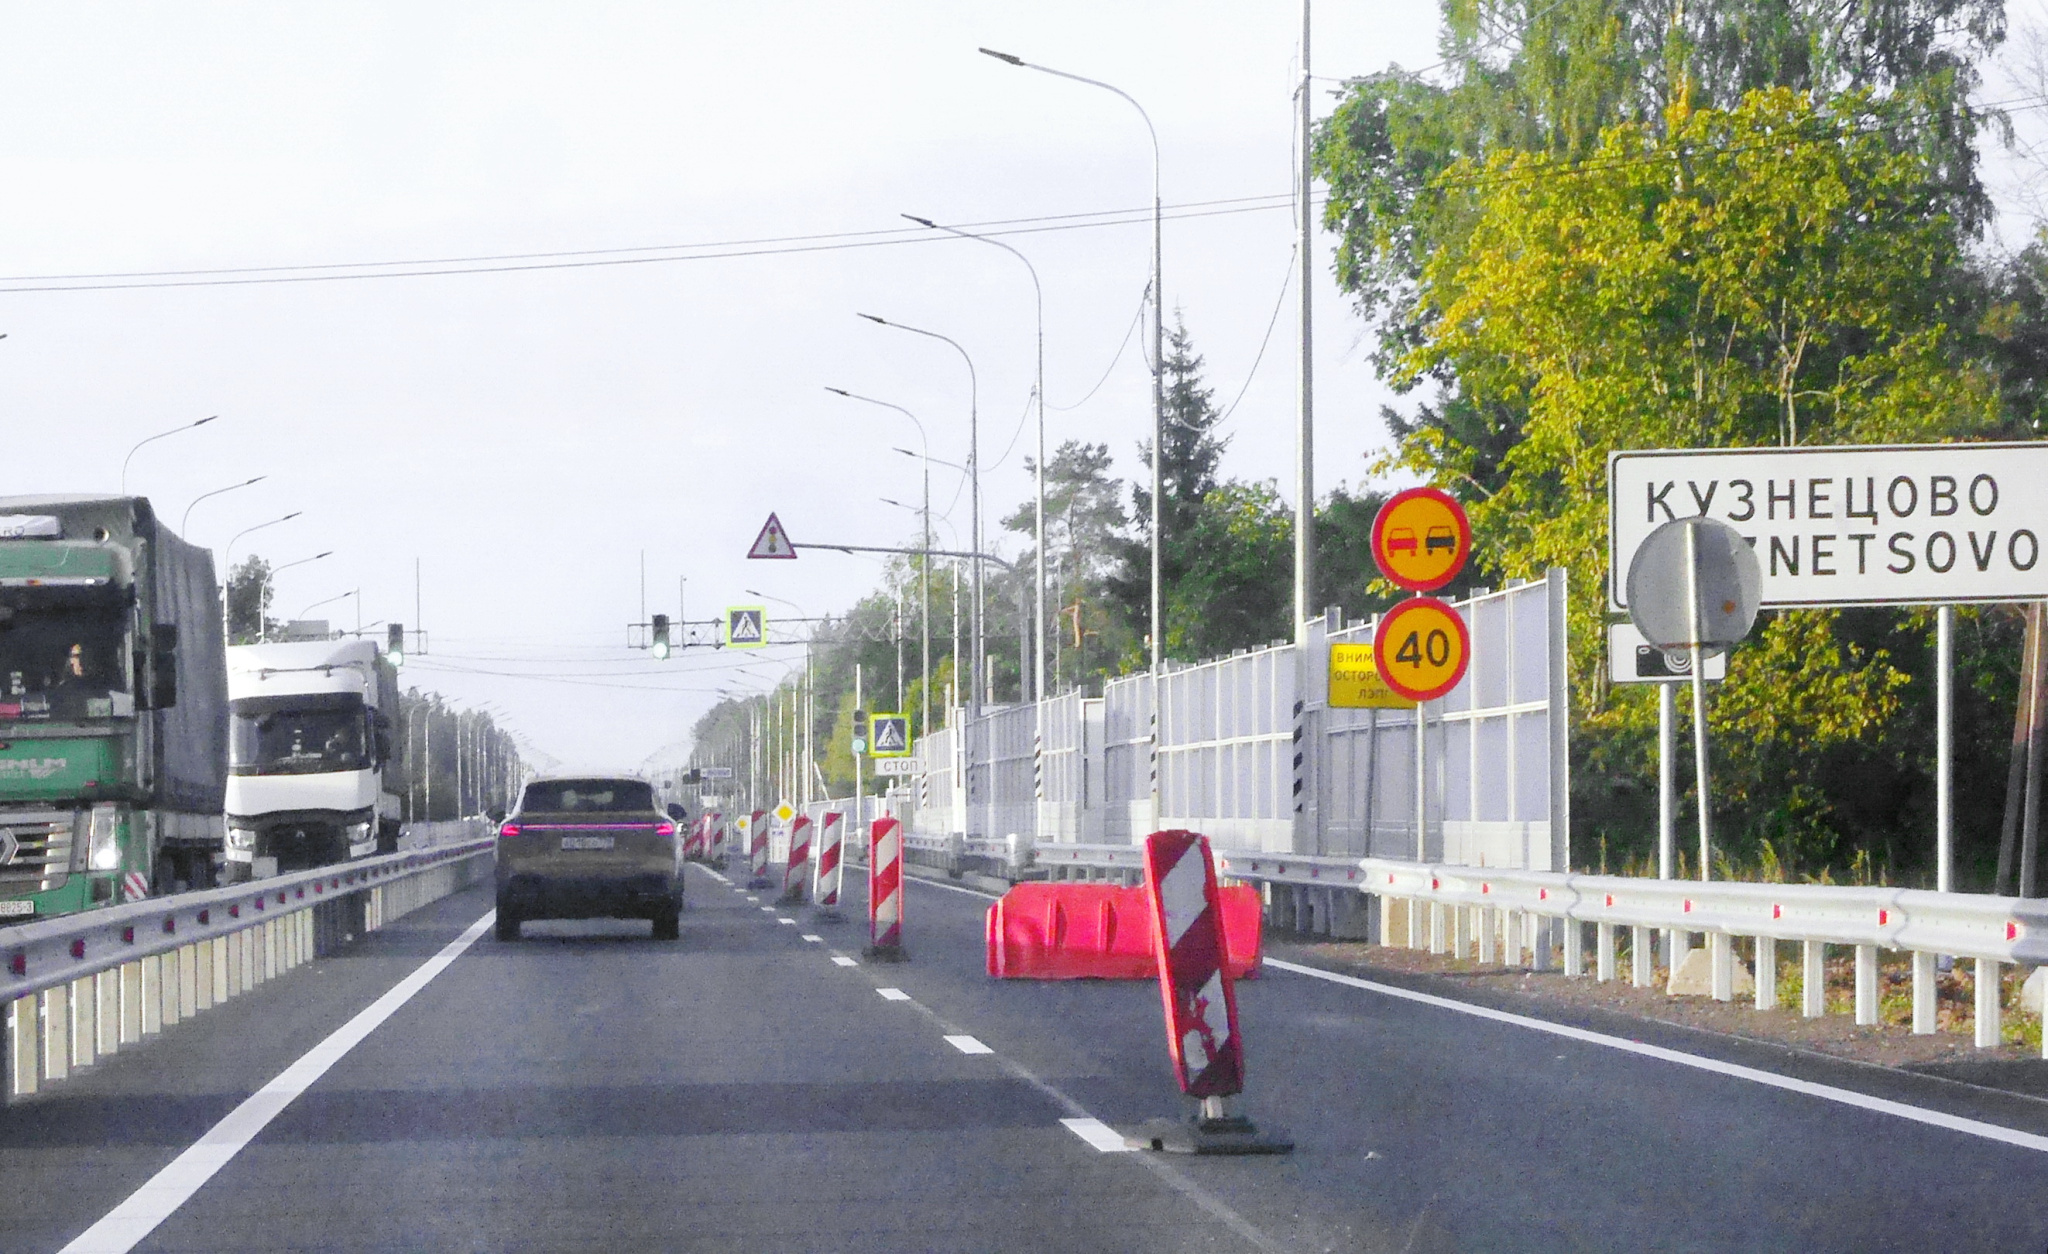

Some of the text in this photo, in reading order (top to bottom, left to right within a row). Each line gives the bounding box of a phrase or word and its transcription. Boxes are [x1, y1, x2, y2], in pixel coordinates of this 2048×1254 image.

[1646, 473, 1999, 526] КУЗНЕЦОВО
[1743, 528, 2039, 577] NETSOVO
[1337, 652, 1373, 663] ВНИМ
[1395, 628, 1450, 669] 40
[884, 760, 918, 772] СТОП
